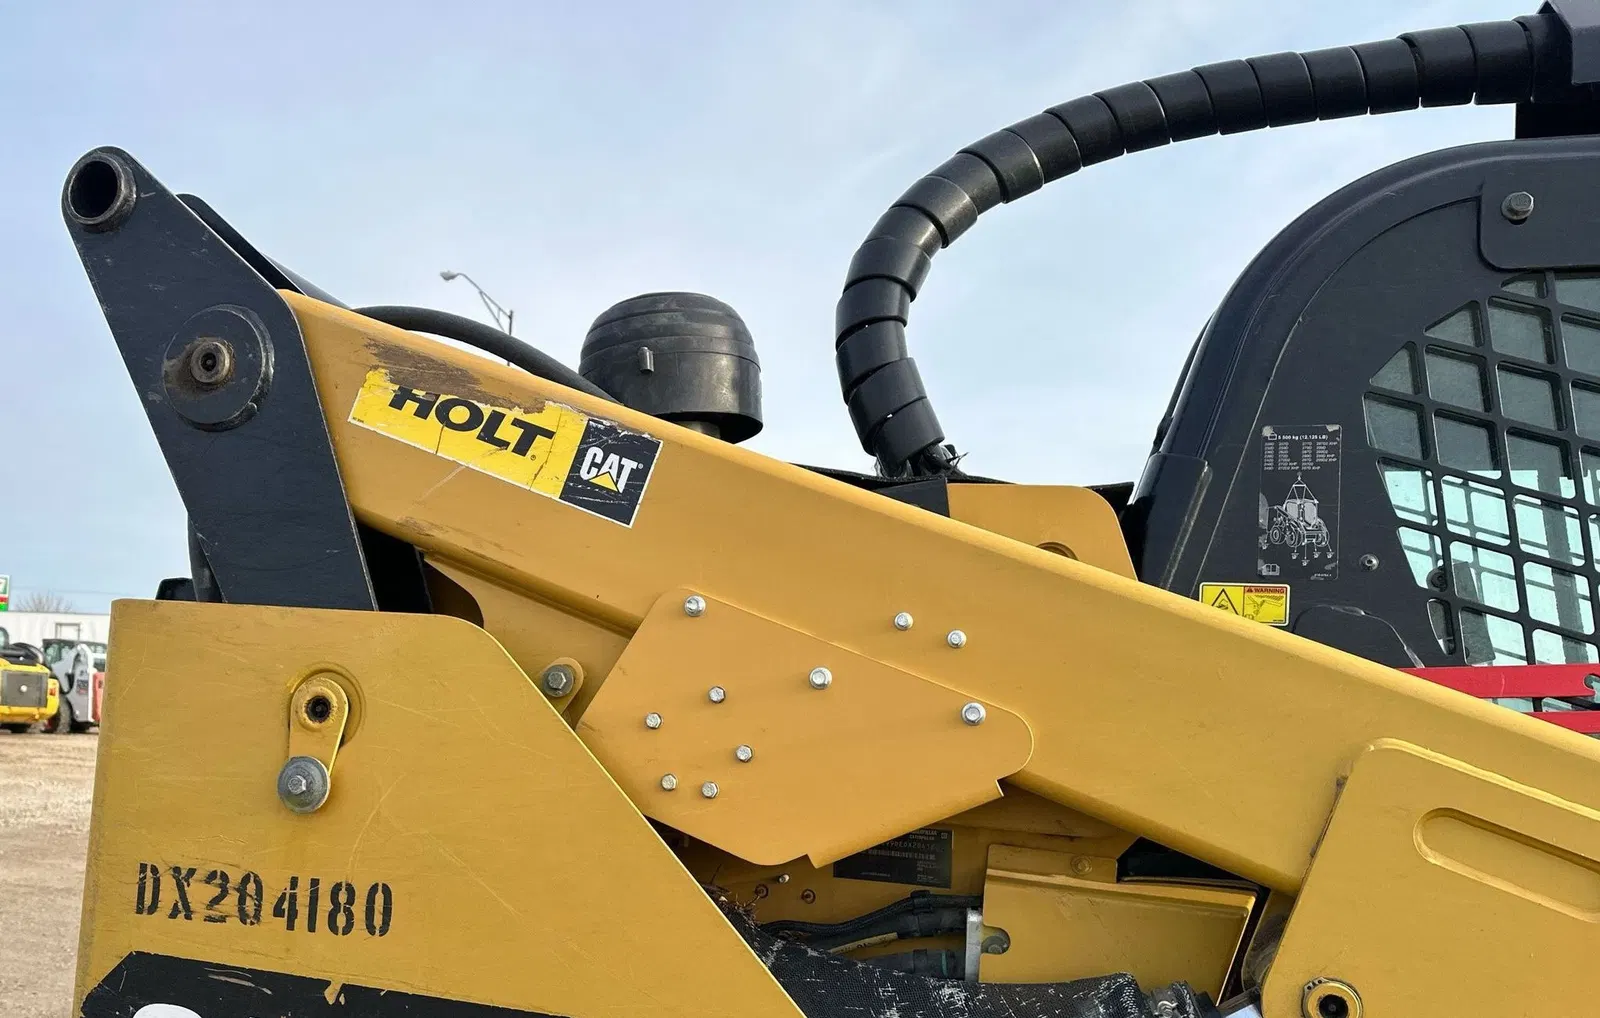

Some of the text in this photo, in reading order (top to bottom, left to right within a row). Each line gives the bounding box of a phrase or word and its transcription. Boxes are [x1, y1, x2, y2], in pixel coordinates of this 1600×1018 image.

[389, 385, 557, 457] HOLT
[580, 446, 638, 493] CAT
[136, 862, 393, 937] DX204180
